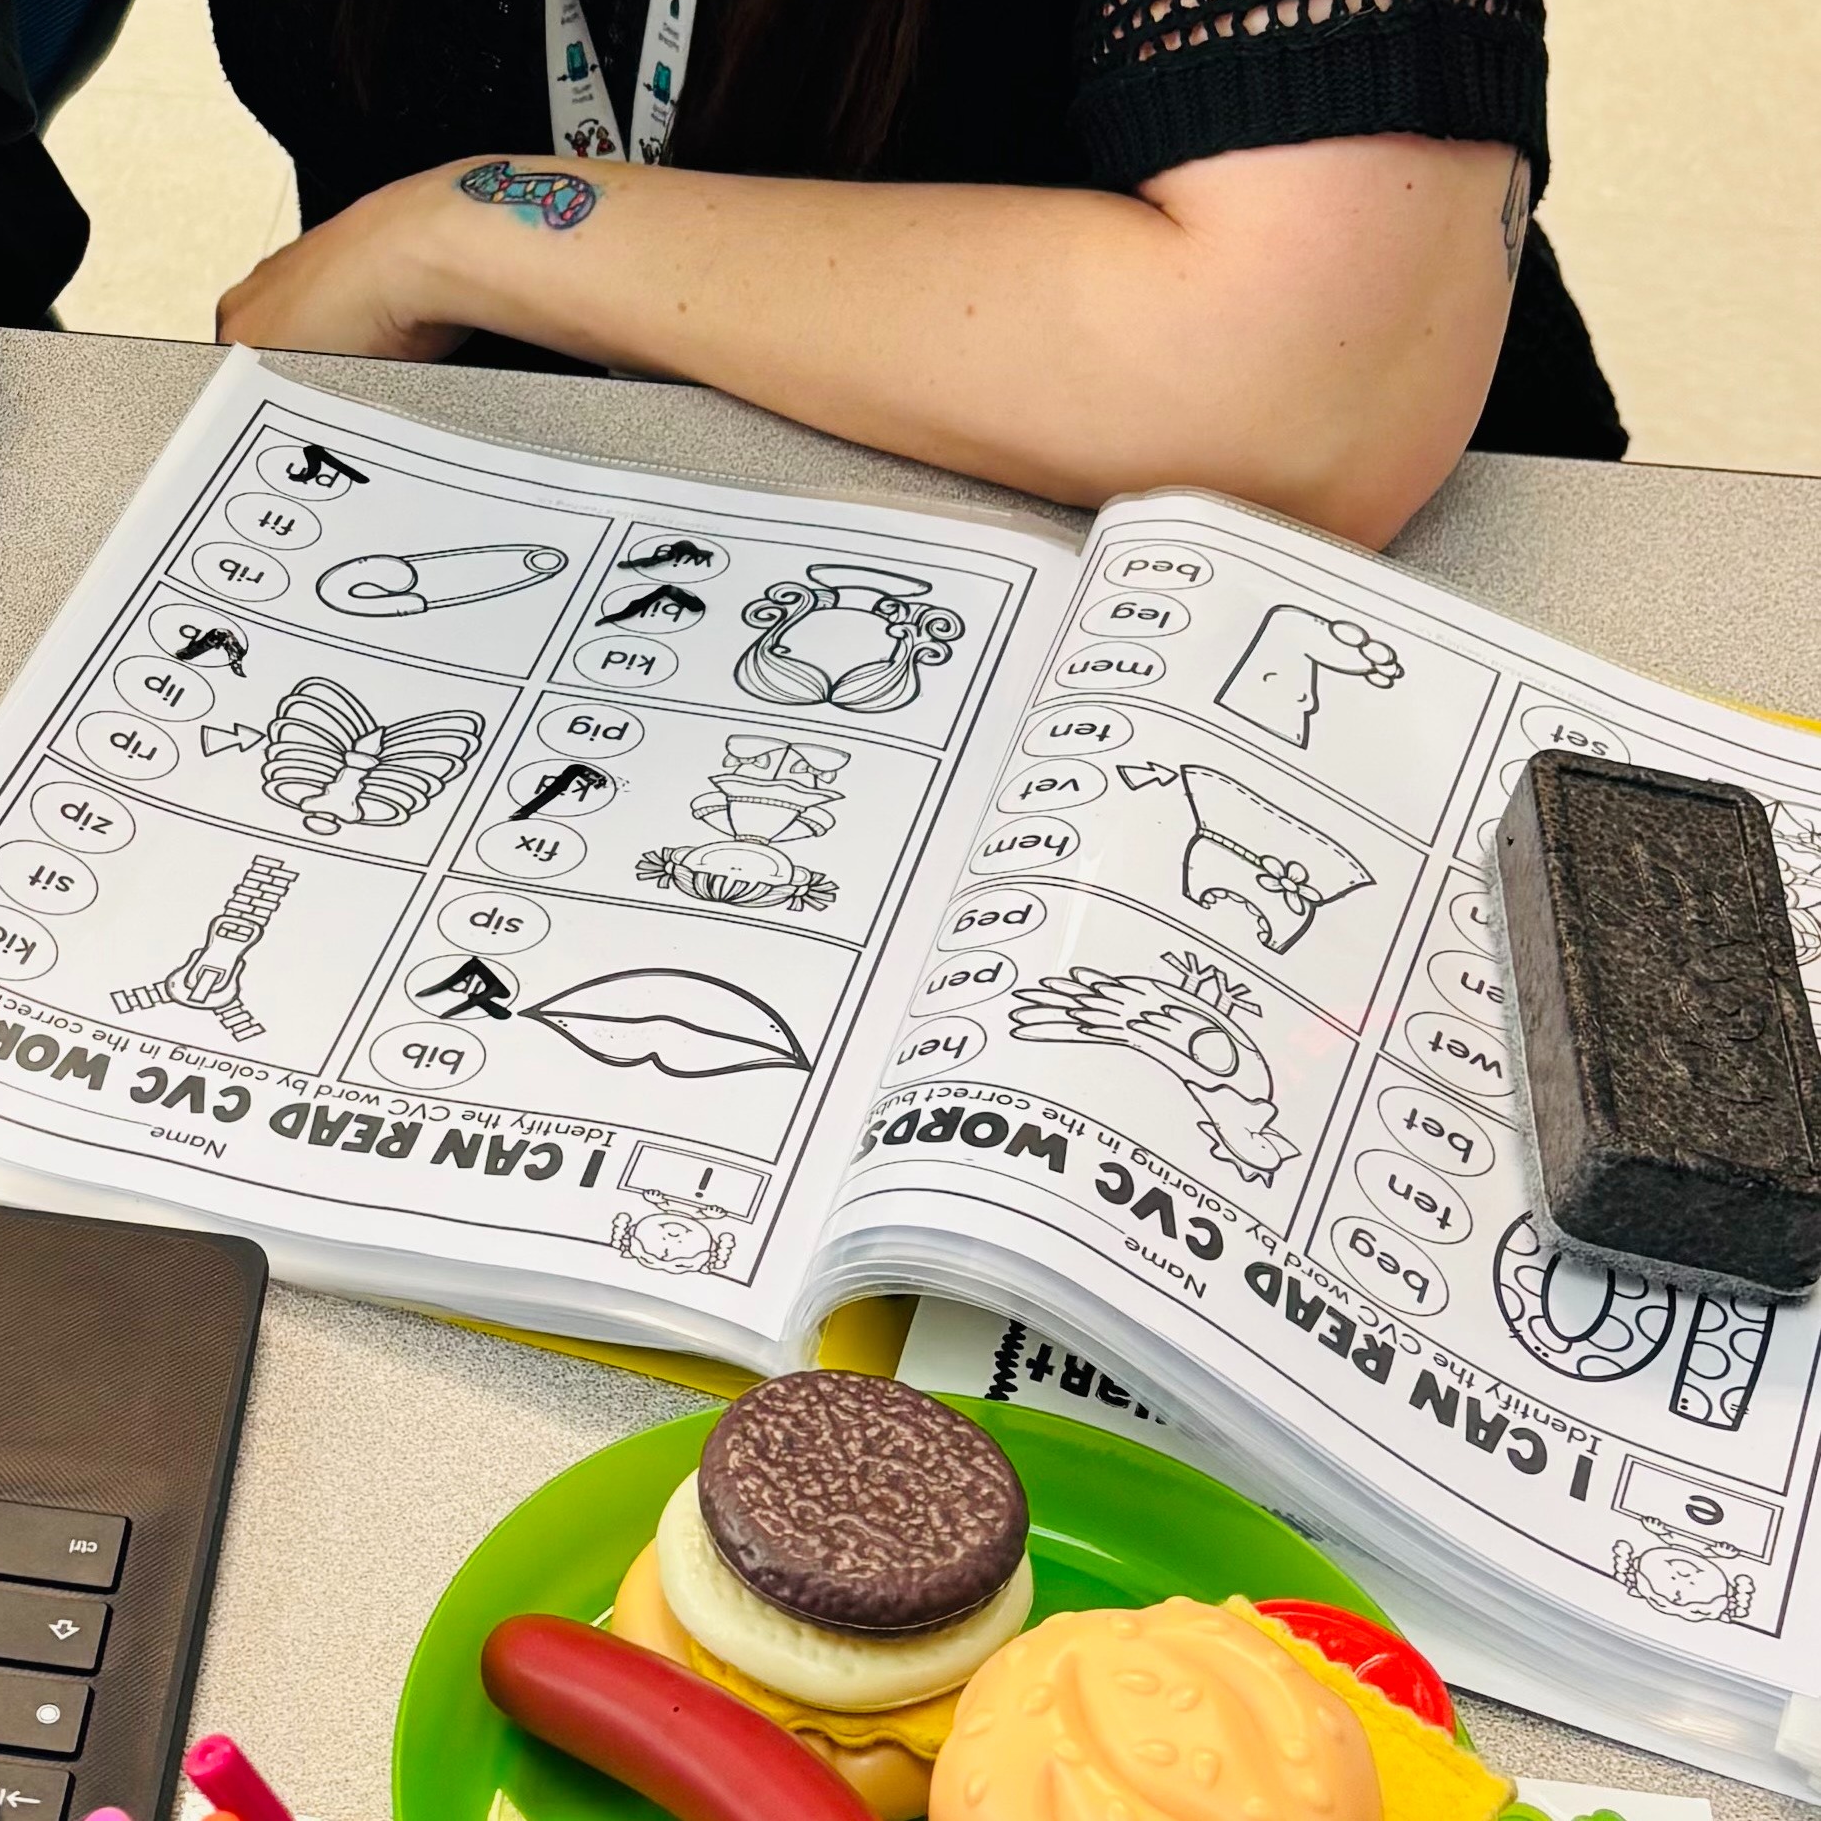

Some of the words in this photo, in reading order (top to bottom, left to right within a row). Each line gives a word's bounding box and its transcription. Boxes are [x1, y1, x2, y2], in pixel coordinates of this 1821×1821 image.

[259, 511, 295, 535] fit
[219, 559, 264, 583] rib
[1123, 551, 1203, 582] bed
[1111, 602, 1170, 628] leg
[601, 651, 656, 675] kid
[1068, 660, 1153, 676] men
[145, 675, 184, 707] lip
[567, 716, 629, 741] pig
[1050, 723, 1110, 741] ten
[1551, 725, 1608, 755] set
[110, 731, 157, 760] rip
[534, 774, 590, 802] kd
[1020, 779, 1079, 800] vet
[61, 802, 113, 834] zip
[515, 836, 559, 861] fix
[984, 835, 1069, 857] hem
[29, 866, 74, 892] sit
[470, 908, 523, 934] sip
[953, 904, 1032, 934] peg
[927, 962, 1003, 994] pen
[1460, 971, 1507, 1007] en
[92, 1030, 129, 1052] the
[140, 1043, 160, 1059] in
[897, 1036, 968, 1065] hen
[1429, 1031, 1502, 1078] wet
[169, 1045, 269, 1085] coloring
[403, 1043, 464, 1074] bib
[129, 1066, 252, 1122] CVC
[276, 1071, 308, 1096] by
[314, 1085, 379, 1105] word
[925, 1088, 1030, 1109] correct
[387, 1098, 450, 1122] CVC
[462, 1111, 500, 1129] the
[1043, 1108, 1085, 1136] the
[151, 1125, 226, 1159] Name
[269, 1103, 422, 1159] READ
[507, 1114, 617, 1147] Identify
[849, 1107, 1068, 1174] WORDS
[1098, 1132, 1120, 1154] in
[1404, 1108, 1473, 1163] bet
[430, 1128, 563, 1181] CAN
[580, 1150, 606, 1188] I
[695, 1168, 713, 1198] i
[1130, 1147, 1237, 1223] coloring
[1095, 1162, 1224, 1261] CVC
[1389, 1174, 1451, 1230] ten
[1245, 1223, 1277, 1256] by
[1123, 1235, 1206, 1298] Name
[1284, 1252, 1348, 1304] word
[1349, 1228, 1429, 1303] beg
[1243, 1261, 1395, 1386] READ
[1357, 1304, 1421, 1355] CVC
[1433, 1353, 1474, 1388] the
[1408, 1369, 1548, 1475] CAN
[1485, 1380, 1602, 1456] Identify
[1570, 1455, 1593, 1501] I
[1686, 1495, 1724, 1525] e
[69, 1539, 97, 1553] ctrl
